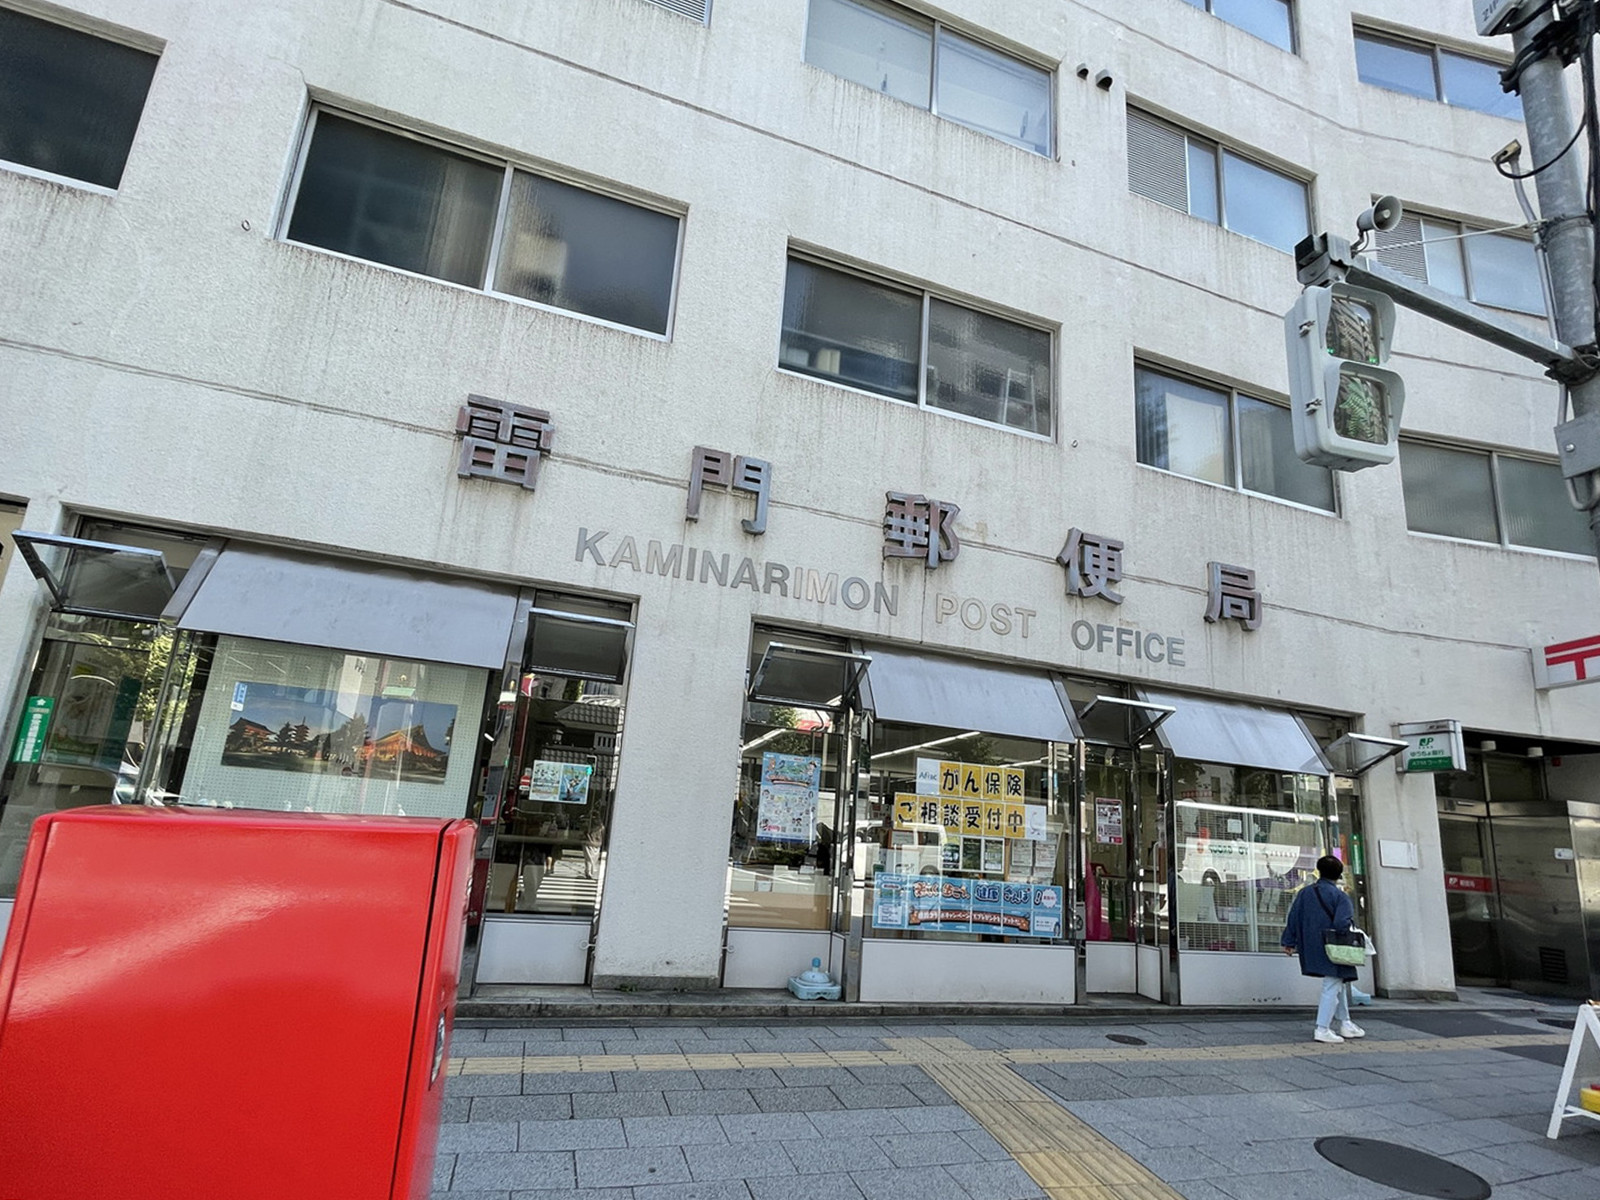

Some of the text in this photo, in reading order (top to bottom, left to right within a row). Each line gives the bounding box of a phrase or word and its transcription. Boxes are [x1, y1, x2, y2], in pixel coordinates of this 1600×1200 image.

[456, 394, 1264, 634] 雷門郵便局
[575, 526, 1187, 668] KAMINARIMON POST OFFICE
[897, 801, 1023, 833] ご相談受付中
[942, 768, 1022, 797] がん保険
